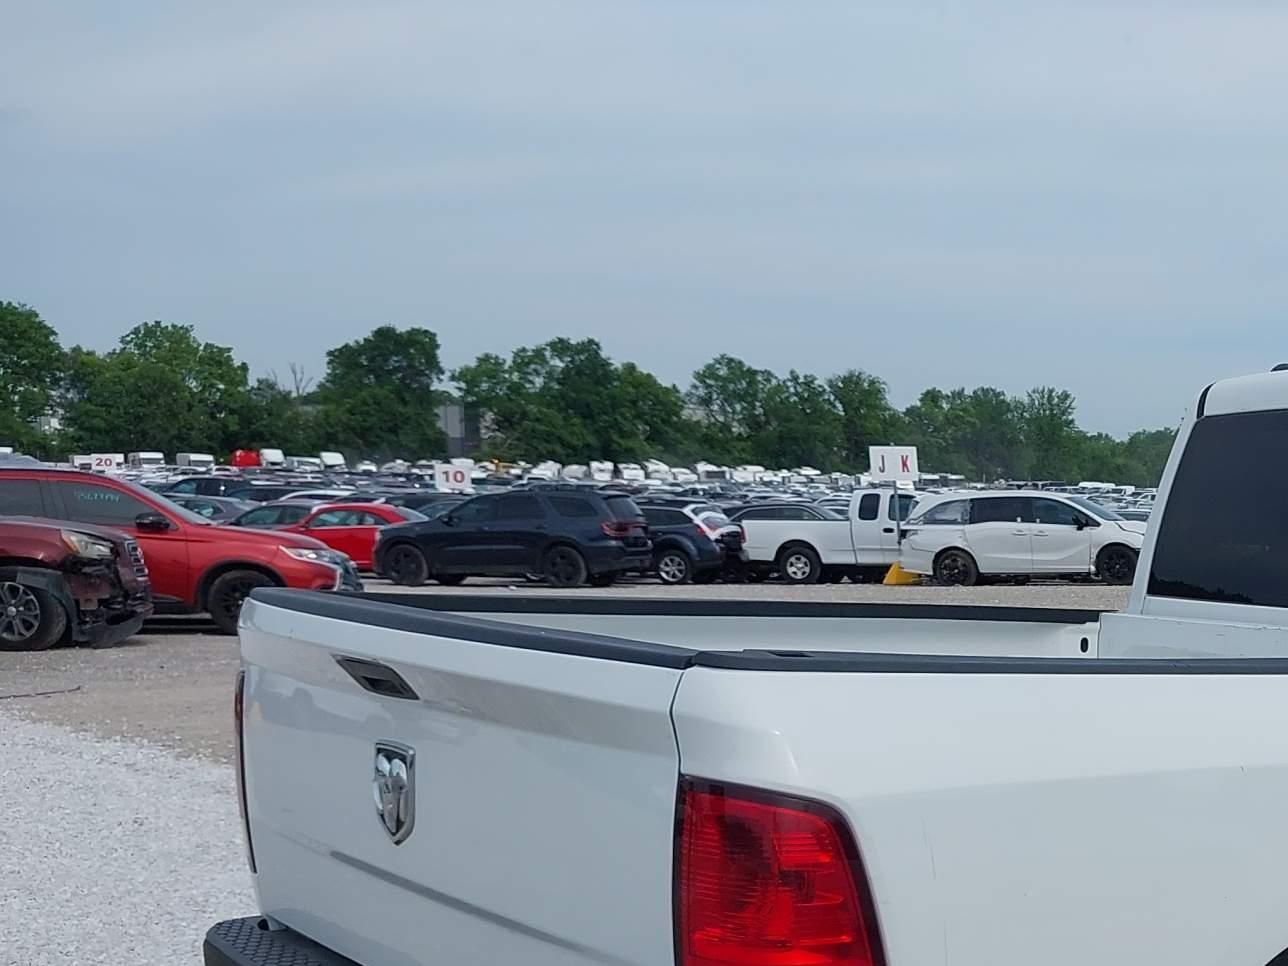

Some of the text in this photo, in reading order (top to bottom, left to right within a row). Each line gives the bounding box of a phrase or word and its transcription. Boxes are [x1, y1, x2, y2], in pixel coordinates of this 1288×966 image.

[95, 457, 113, 467] 20
[879, 454, 910, 473] J K
[442, 470, 465, 483] 10
